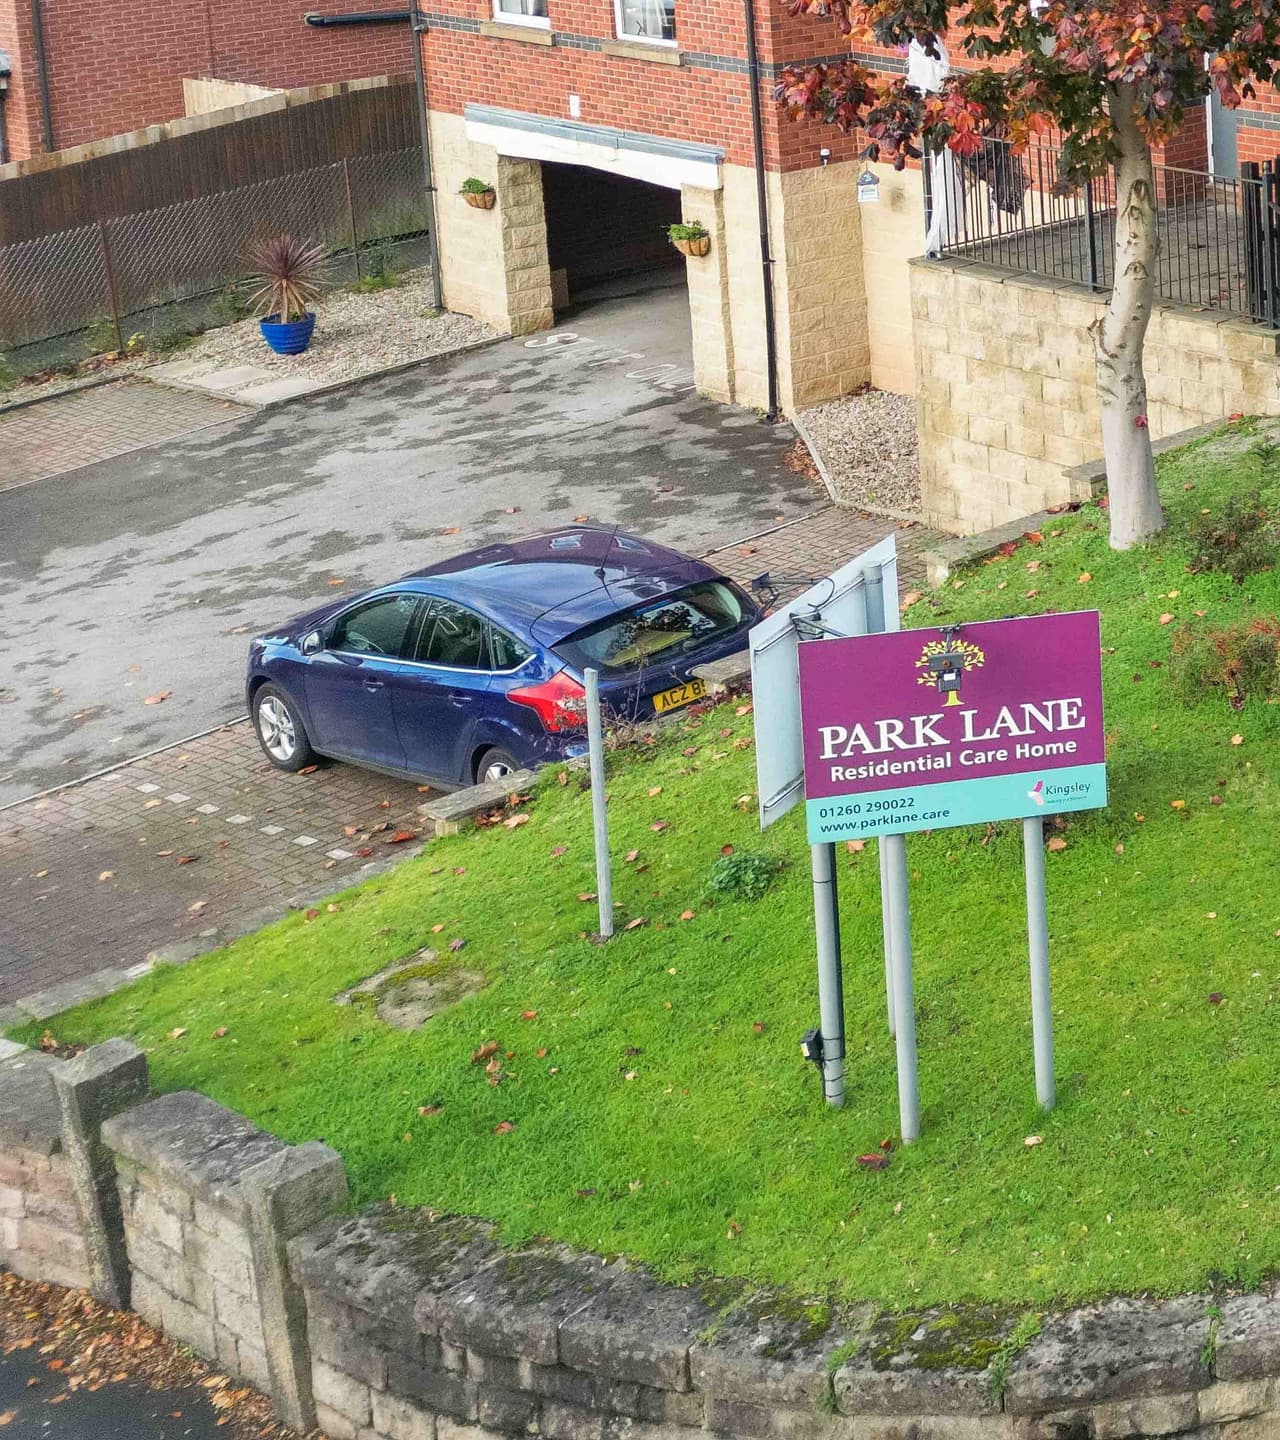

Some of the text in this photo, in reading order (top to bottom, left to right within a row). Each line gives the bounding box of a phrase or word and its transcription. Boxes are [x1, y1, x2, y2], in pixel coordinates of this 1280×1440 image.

[818, 697, 1087, 760] PARK LANE
[830, 740, 1077, 783] Residential Care Home
[1046, 781, 1091, 796] Kingsley
[819, 797, 915, 819] 01260 290022
[820, 809, 951, 833] www.parklane.care
